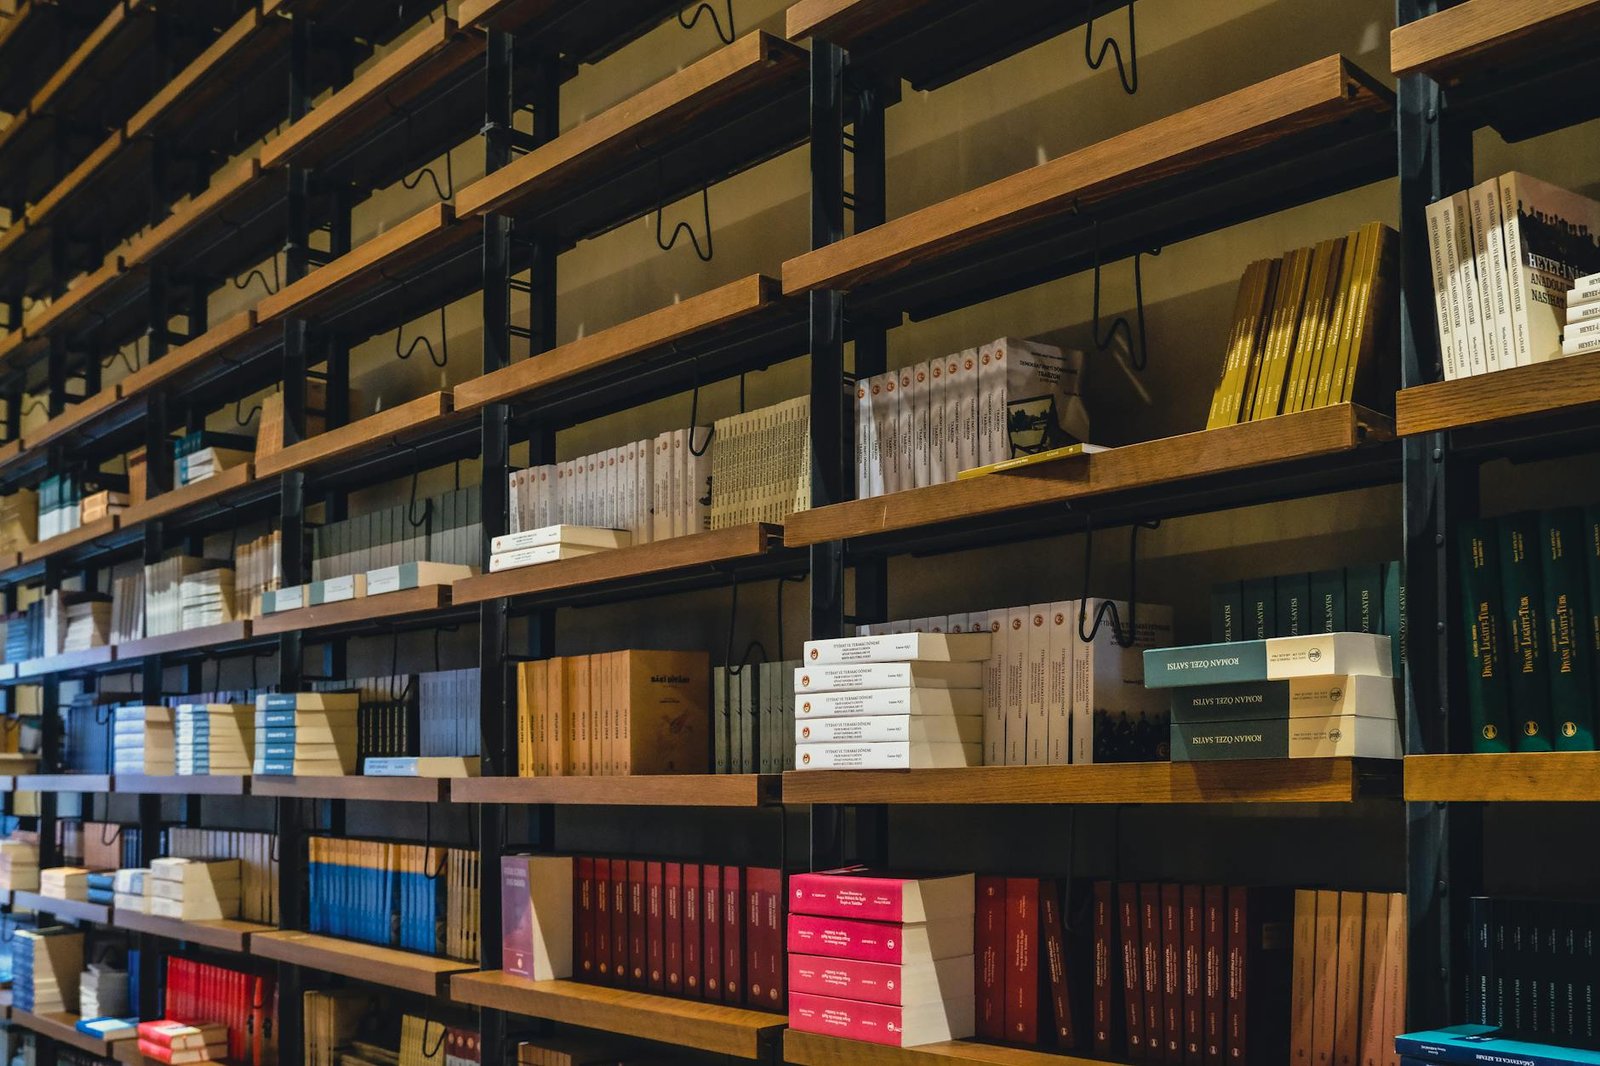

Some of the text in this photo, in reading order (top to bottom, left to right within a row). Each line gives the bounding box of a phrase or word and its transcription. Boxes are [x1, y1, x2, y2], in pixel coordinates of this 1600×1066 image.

[1528, 252, 1567, 278] HEYET-İ
[1167, 657, 1239, 671] ROMAN ÖZEL SAYISI
[1192, 694, 1263, 706] ROMAN ÖZEL SAYISI
[1192, 734, 1262, 744] ROMAN ÖZEL SAYISI
